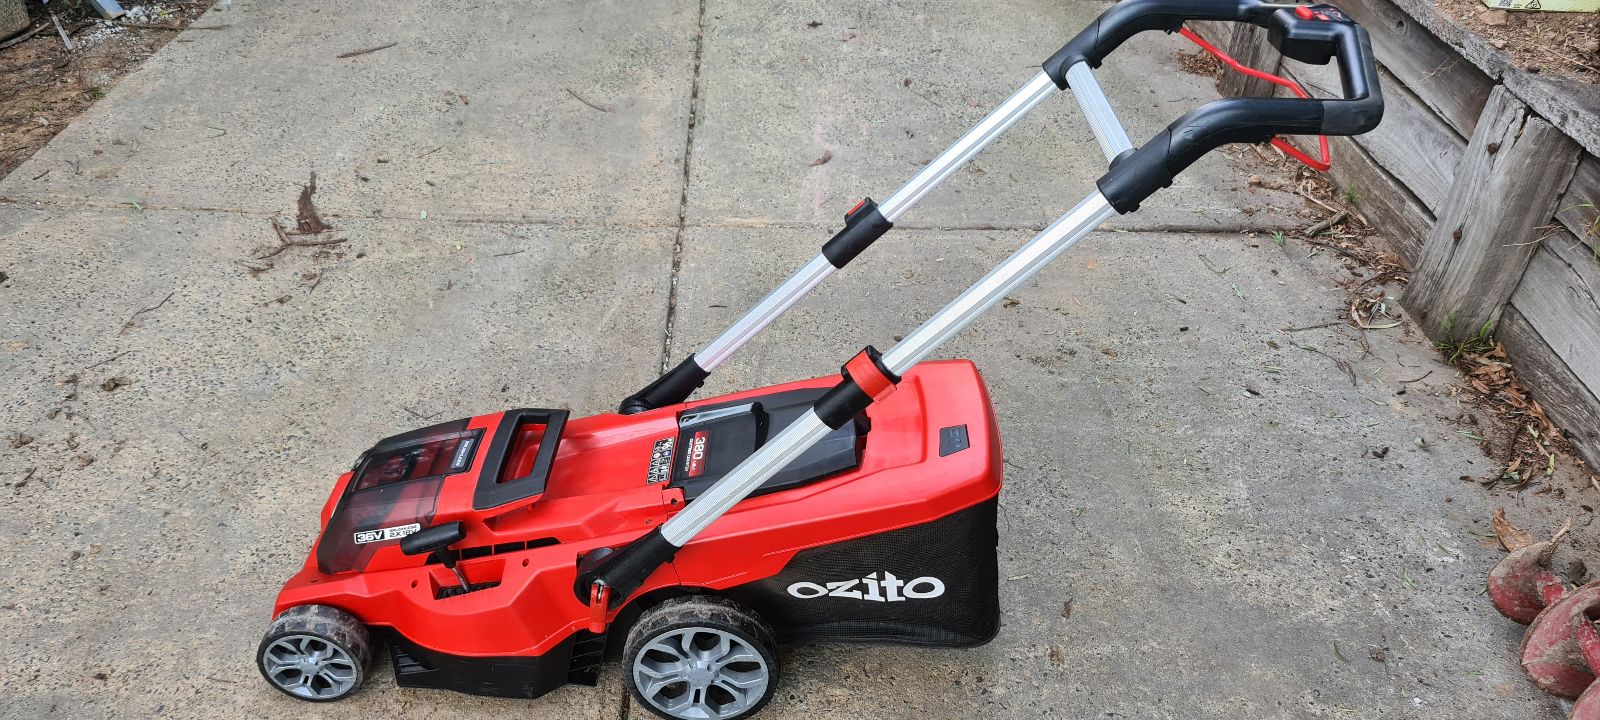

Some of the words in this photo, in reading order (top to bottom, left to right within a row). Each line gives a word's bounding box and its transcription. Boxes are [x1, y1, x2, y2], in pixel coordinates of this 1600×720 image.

[693, 436, 706, 460] 380
[357, 530, 383, 542] 36V
[787, 570, 945, 602] ozito
